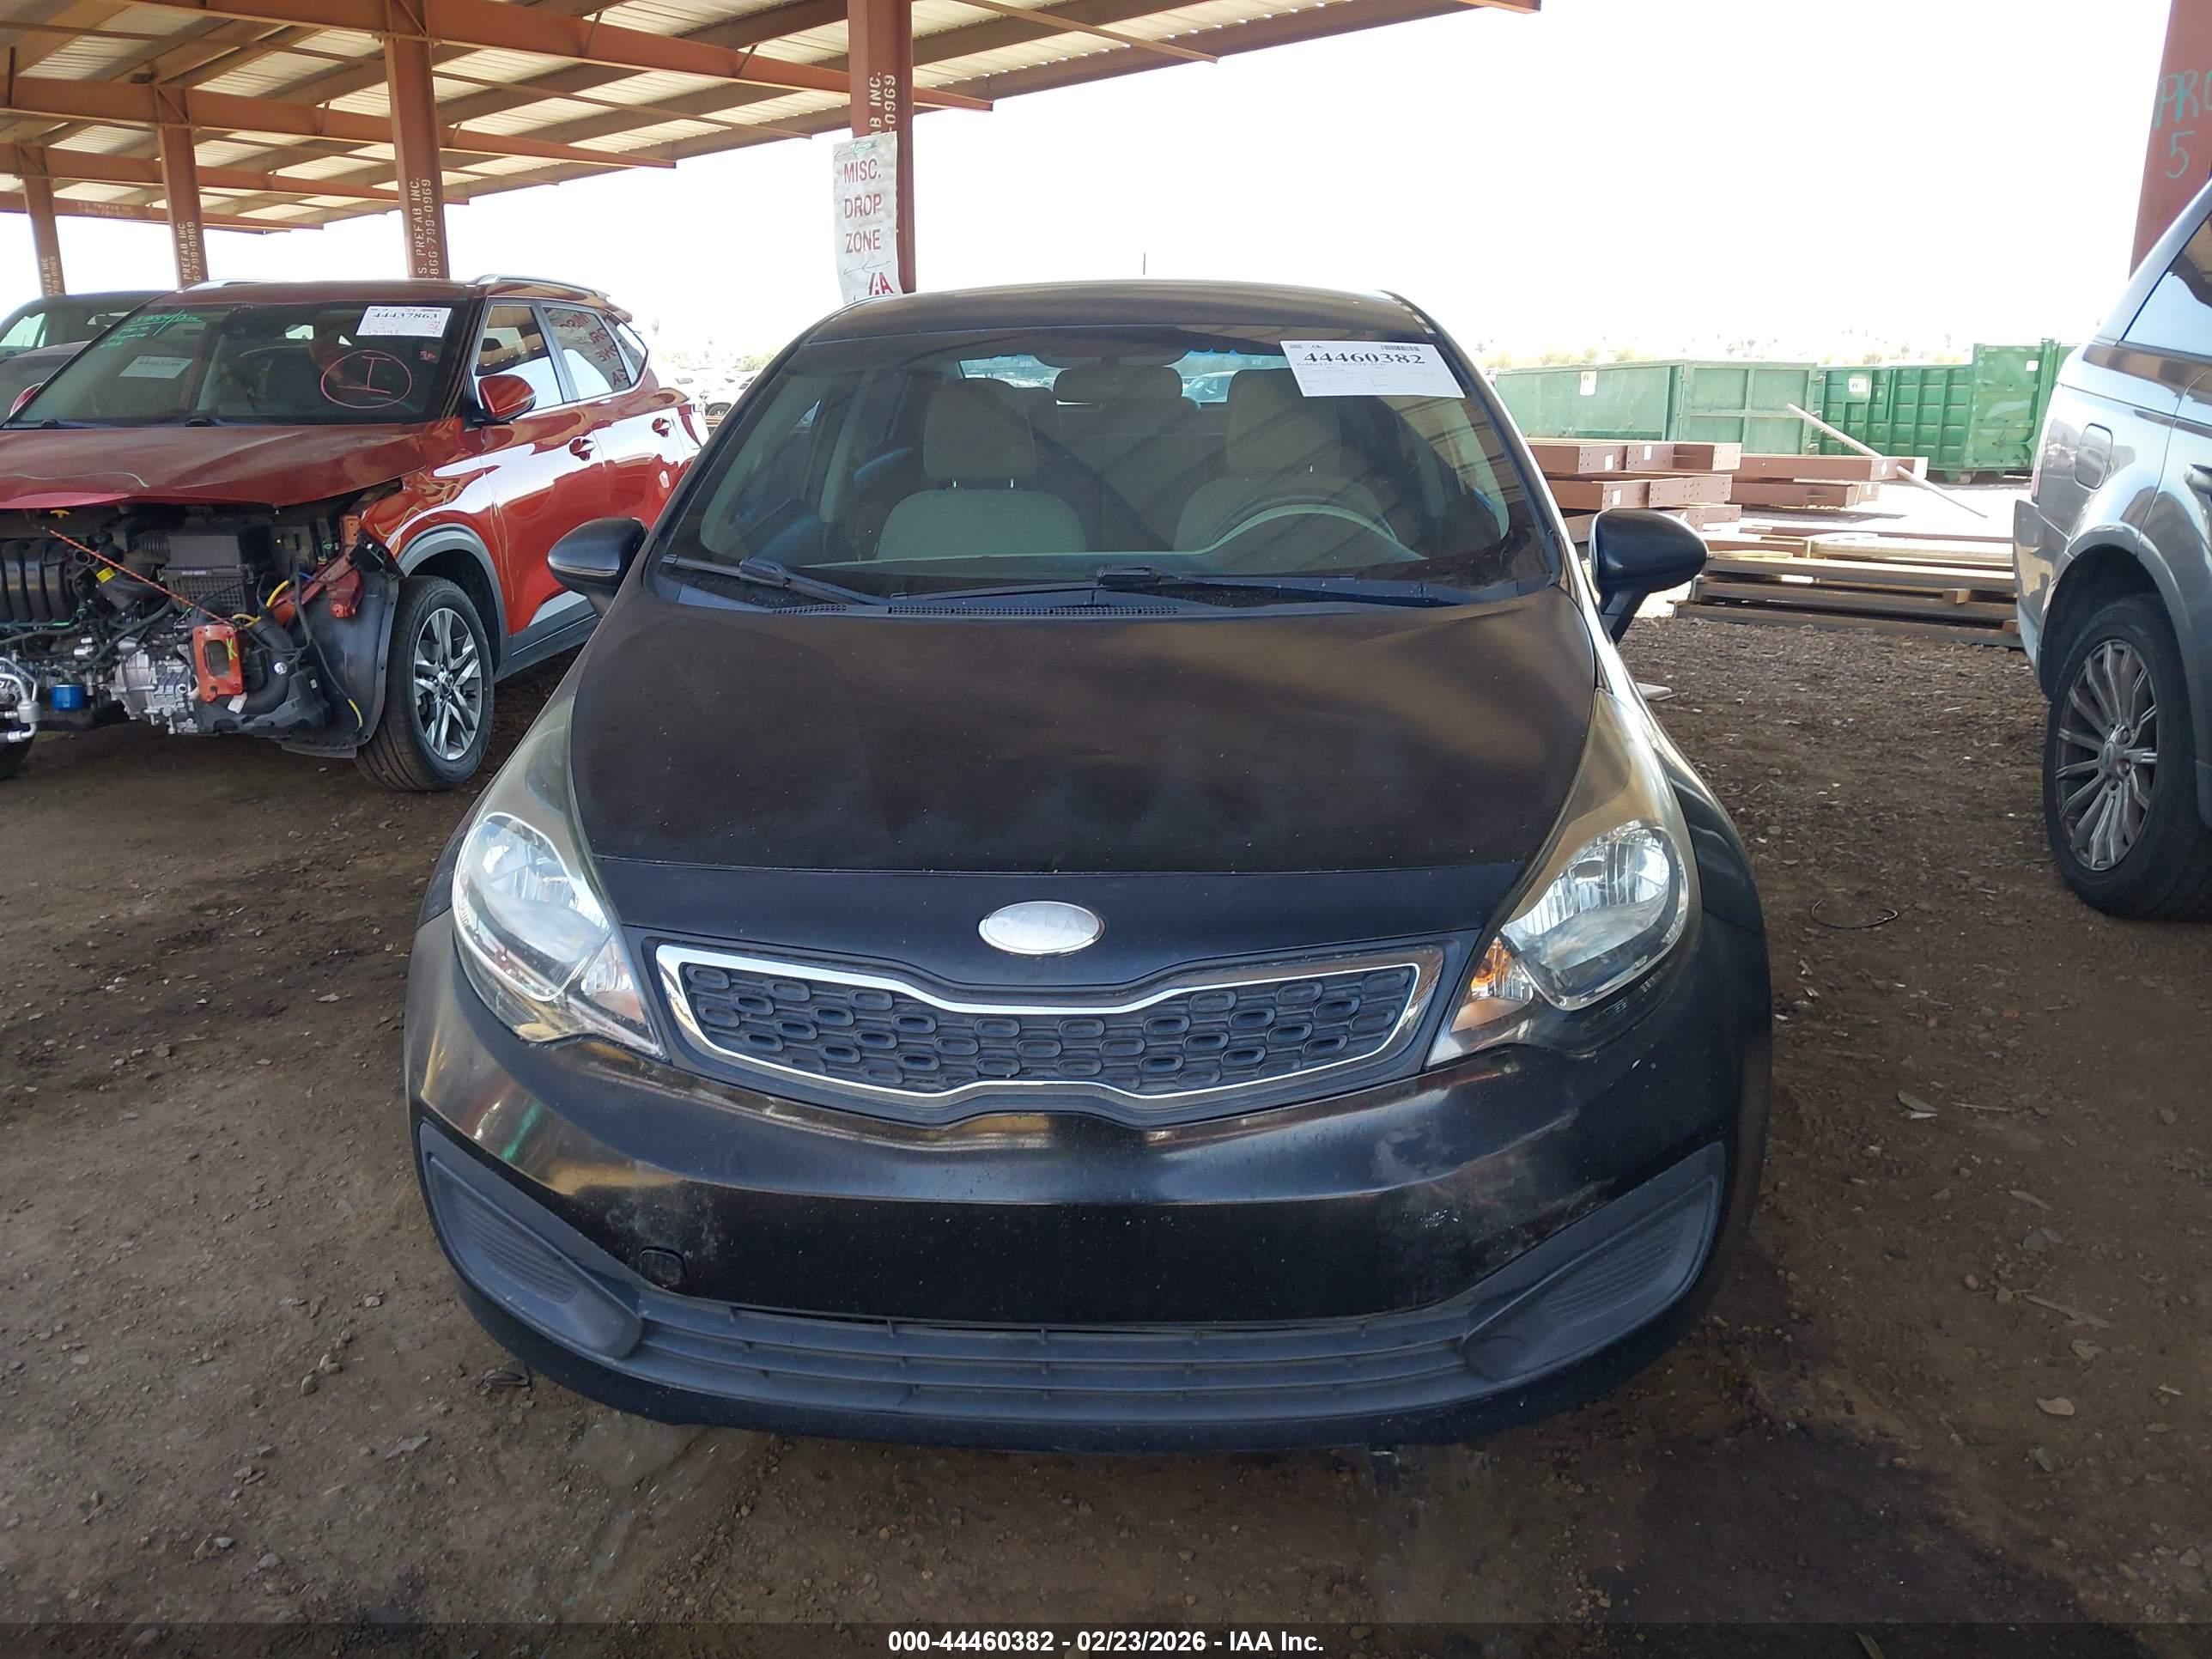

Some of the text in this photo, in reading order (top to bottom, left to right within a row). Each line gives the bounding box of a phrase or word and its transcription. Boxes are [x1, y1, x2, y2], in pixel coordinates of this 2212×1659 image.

[869, 71, 882, 106] INC.
[2166, 130, 2197, 179] 5
[843, 158, 881, 184] MISC.
[410, 178, 422, 201] INC.
[844, 193, 882, 219] DROP
[412, 207, 427, 256] PREFAB
[845, 228, 881, 254] ZONE
[1304, 352, 1425, 364] 44460382
